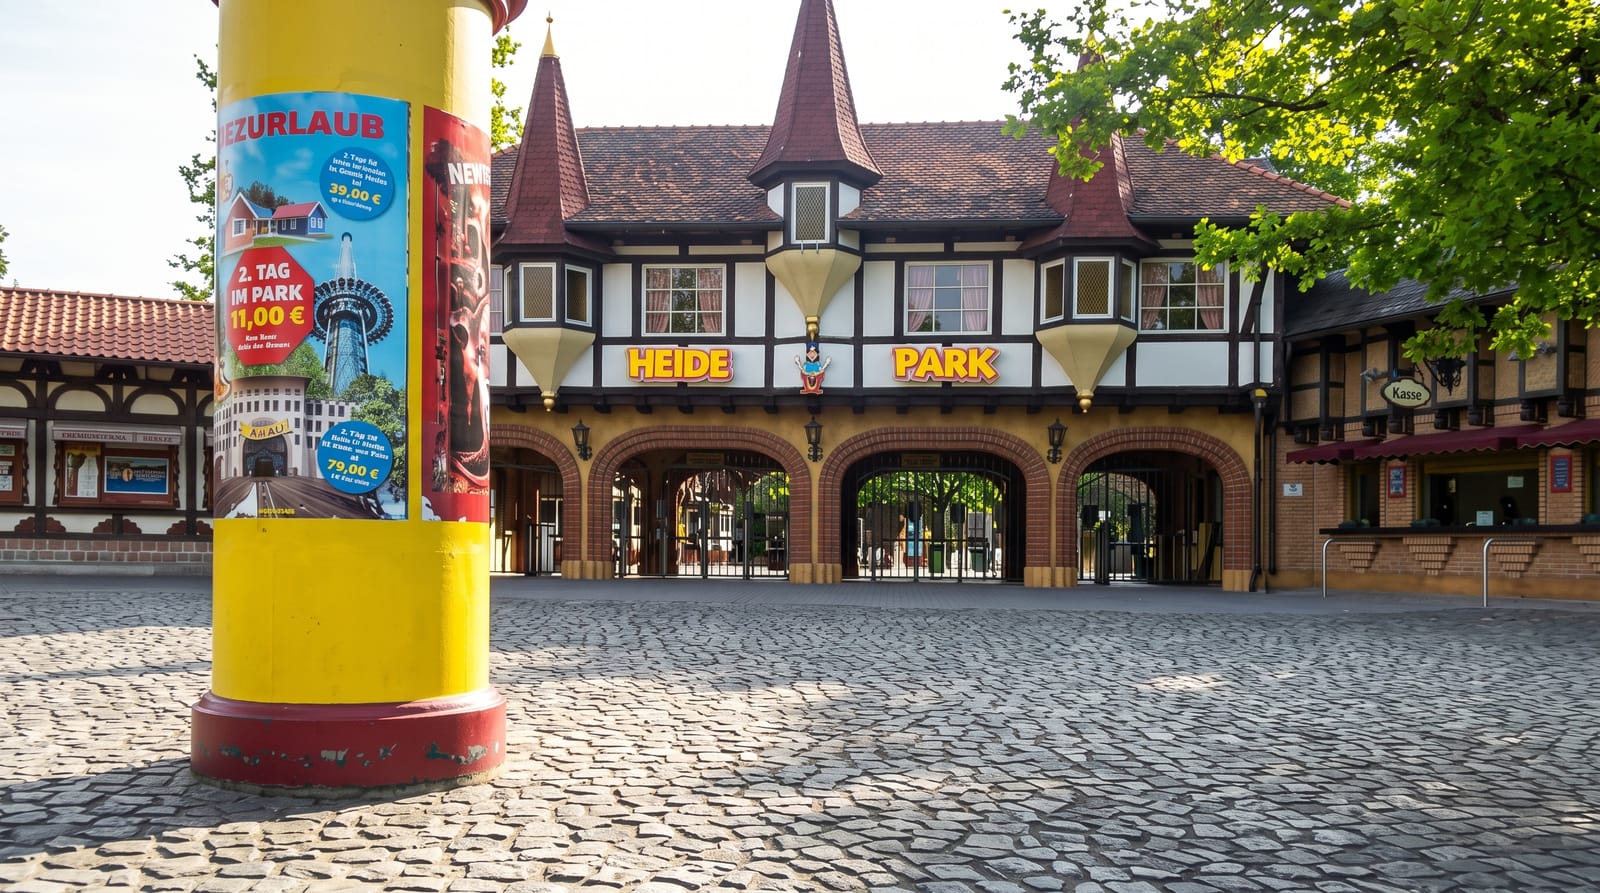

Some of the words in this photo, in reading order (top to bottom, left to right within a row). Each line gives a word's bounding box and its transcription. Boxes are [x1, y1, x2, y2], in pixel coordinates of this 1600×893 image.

[329, 182, 370, 202] 39,00
[371, 193, 382, 205] €
[238, 266, 253, 283] 2.
[256, 262, 290, 281] TAG
[231, 287, 248, 306] IM
[252, 284, 304, 303] PARK
[230, 305, 285, 332] 11,00
[289, 305, 305, 325] €
[626, 347, 731, 380] HEIDE
[892, 346, 999, 382] PARK
[1392, 386, 1422, 400] Kasse
[327, 458, 367, 477] 79,00
[369, 468, 380, 480] €
